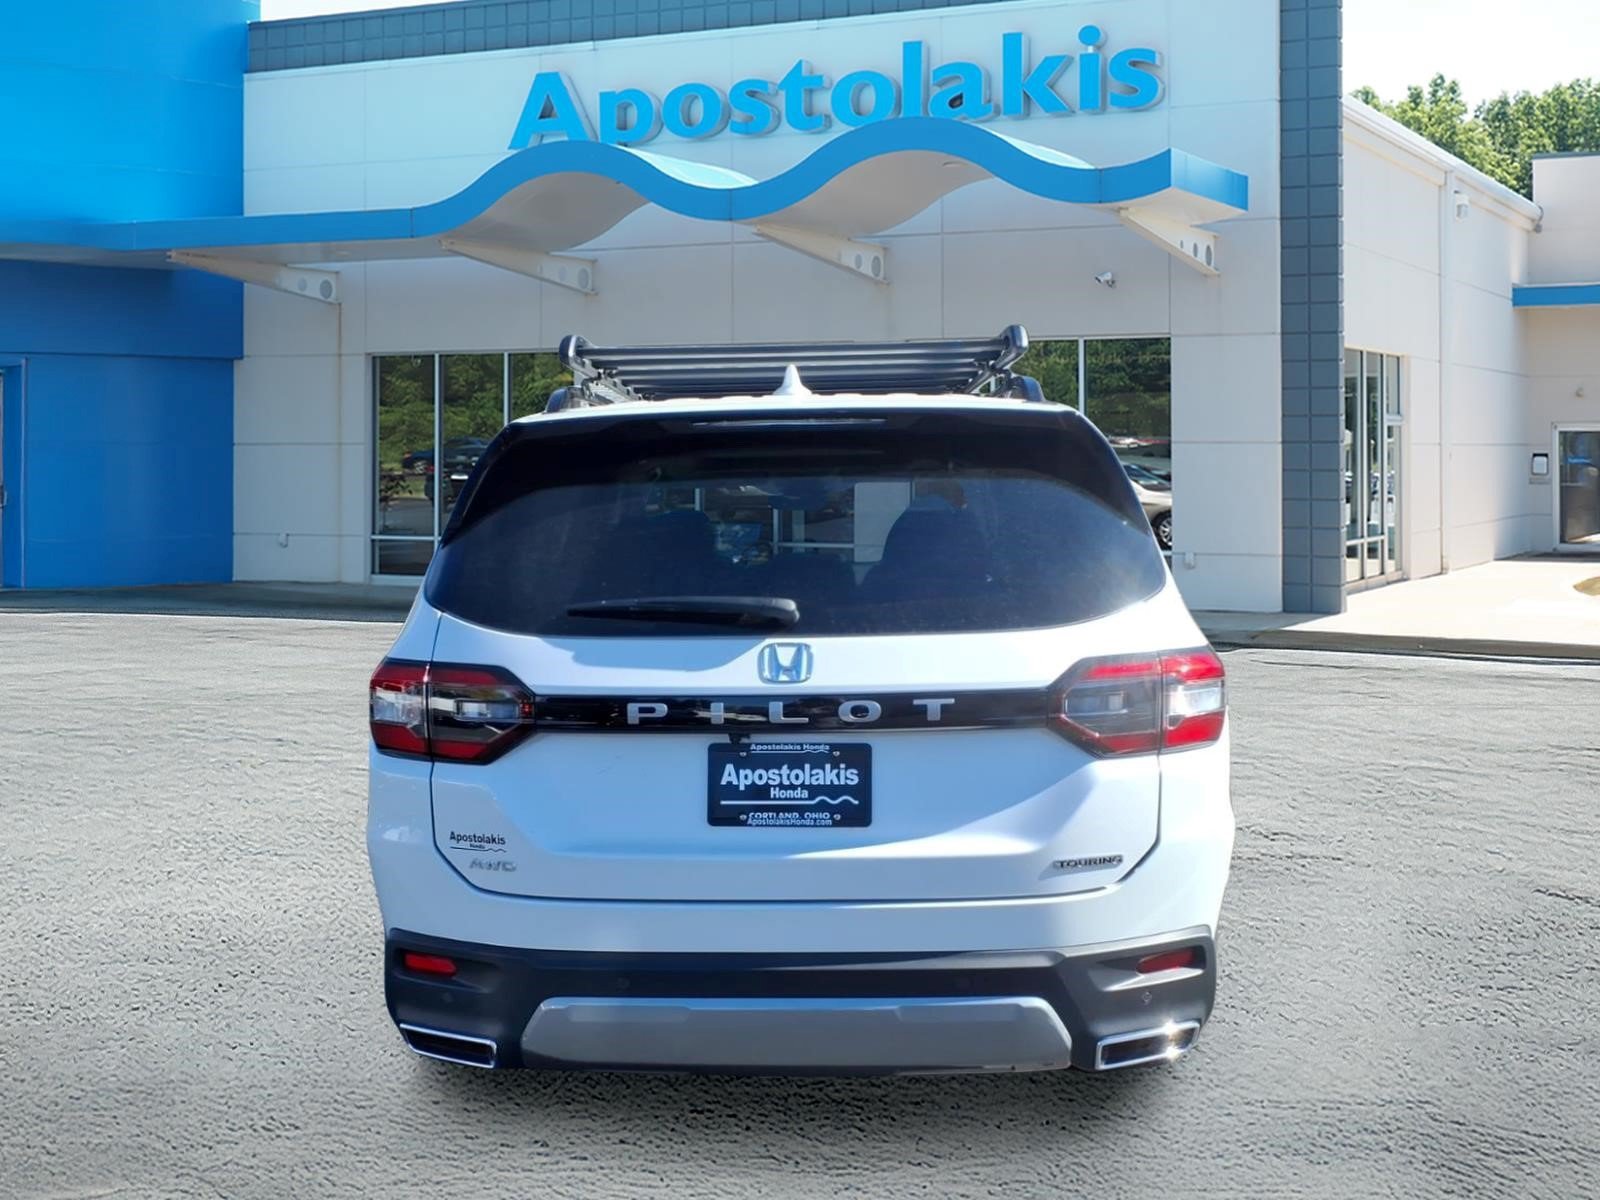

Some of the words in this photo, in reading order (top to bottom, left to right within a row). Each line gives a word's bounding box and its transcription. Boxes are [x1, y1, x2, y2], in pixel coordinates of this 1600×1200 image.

[508, 24, 1165, 150] Apostolakis
[626, 697, 955, 725] PILOT
[802, 743, 830, 751] Honda
[720, 763, 859, 790] Apostolakis
[770, 787, 808, 799] Honda
[747, 818, 832, 826] ApostolakisHonda.com
[804, 812, 830, 820] OHIO
[449, 831, 506, 845] Apostolakis
[1053, 854, 1123, 869] TOURING
